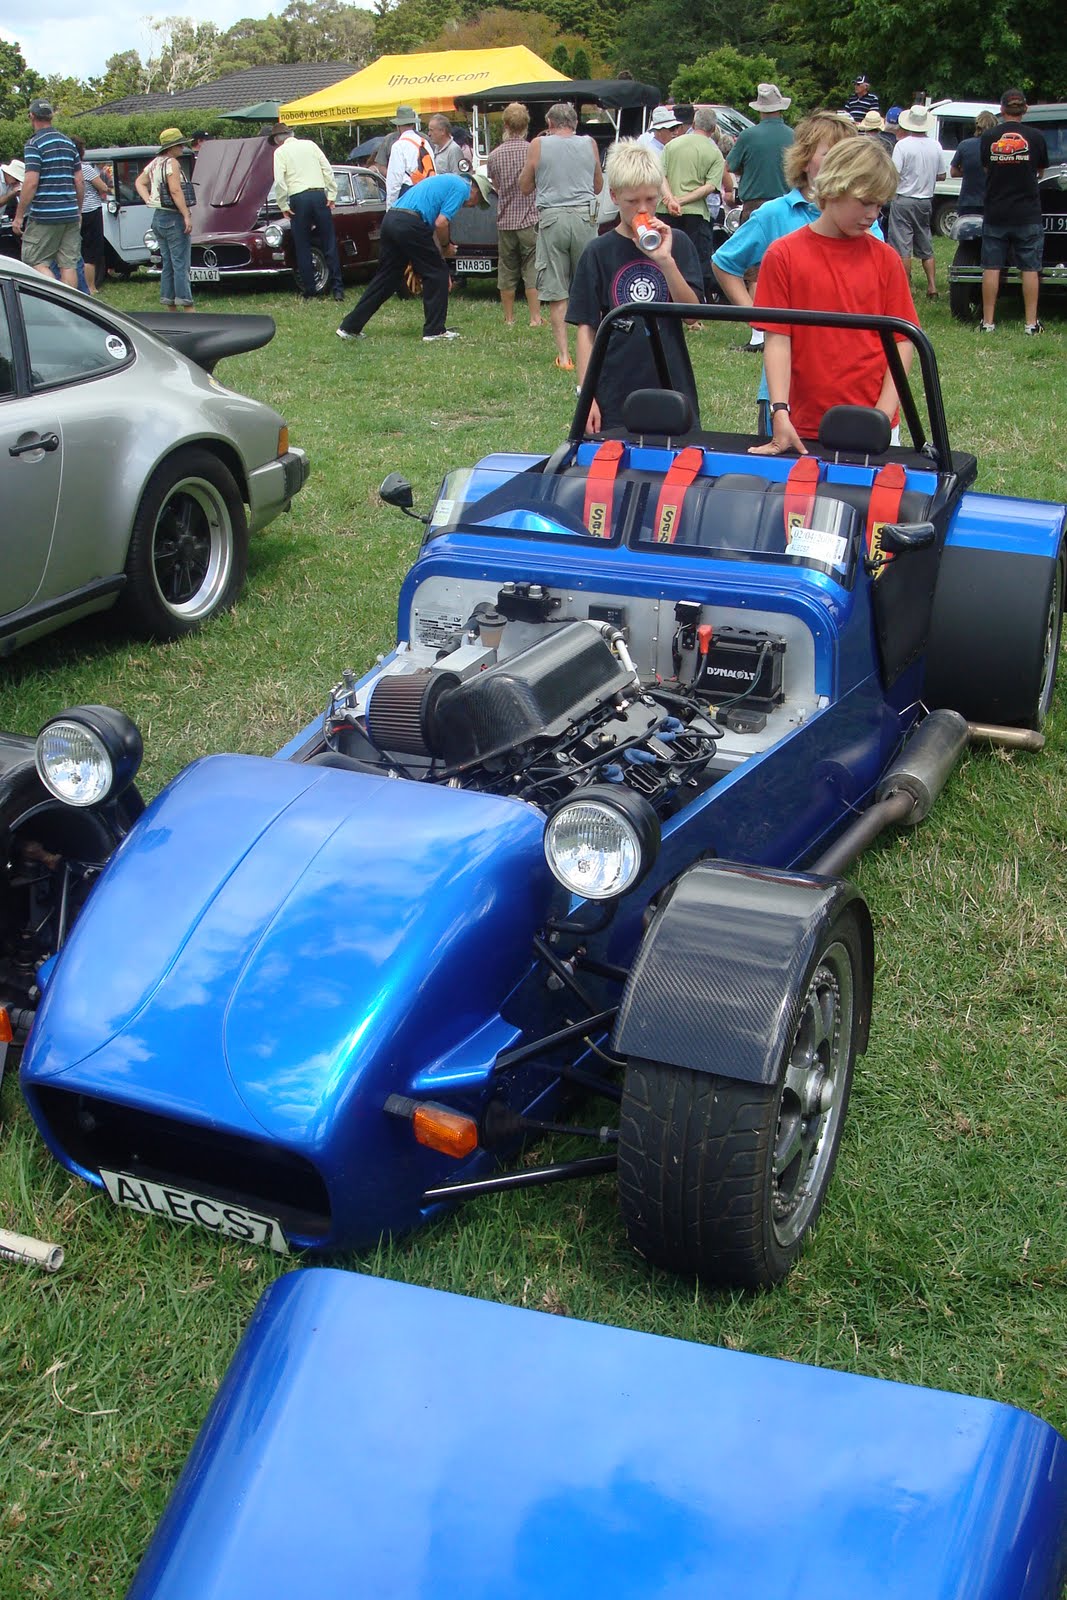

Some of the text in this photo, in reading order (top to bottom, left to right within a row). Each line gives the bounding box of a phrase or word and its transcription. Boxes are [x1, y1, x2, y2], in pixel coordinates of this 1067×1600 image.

[388, 71, 490, 88] ljhooker.com
[281, 106, 359, 121] nobody does it better
[457, 260, 490, 271] ENA836
[117, 1177, 273, 1243] ALECS7
